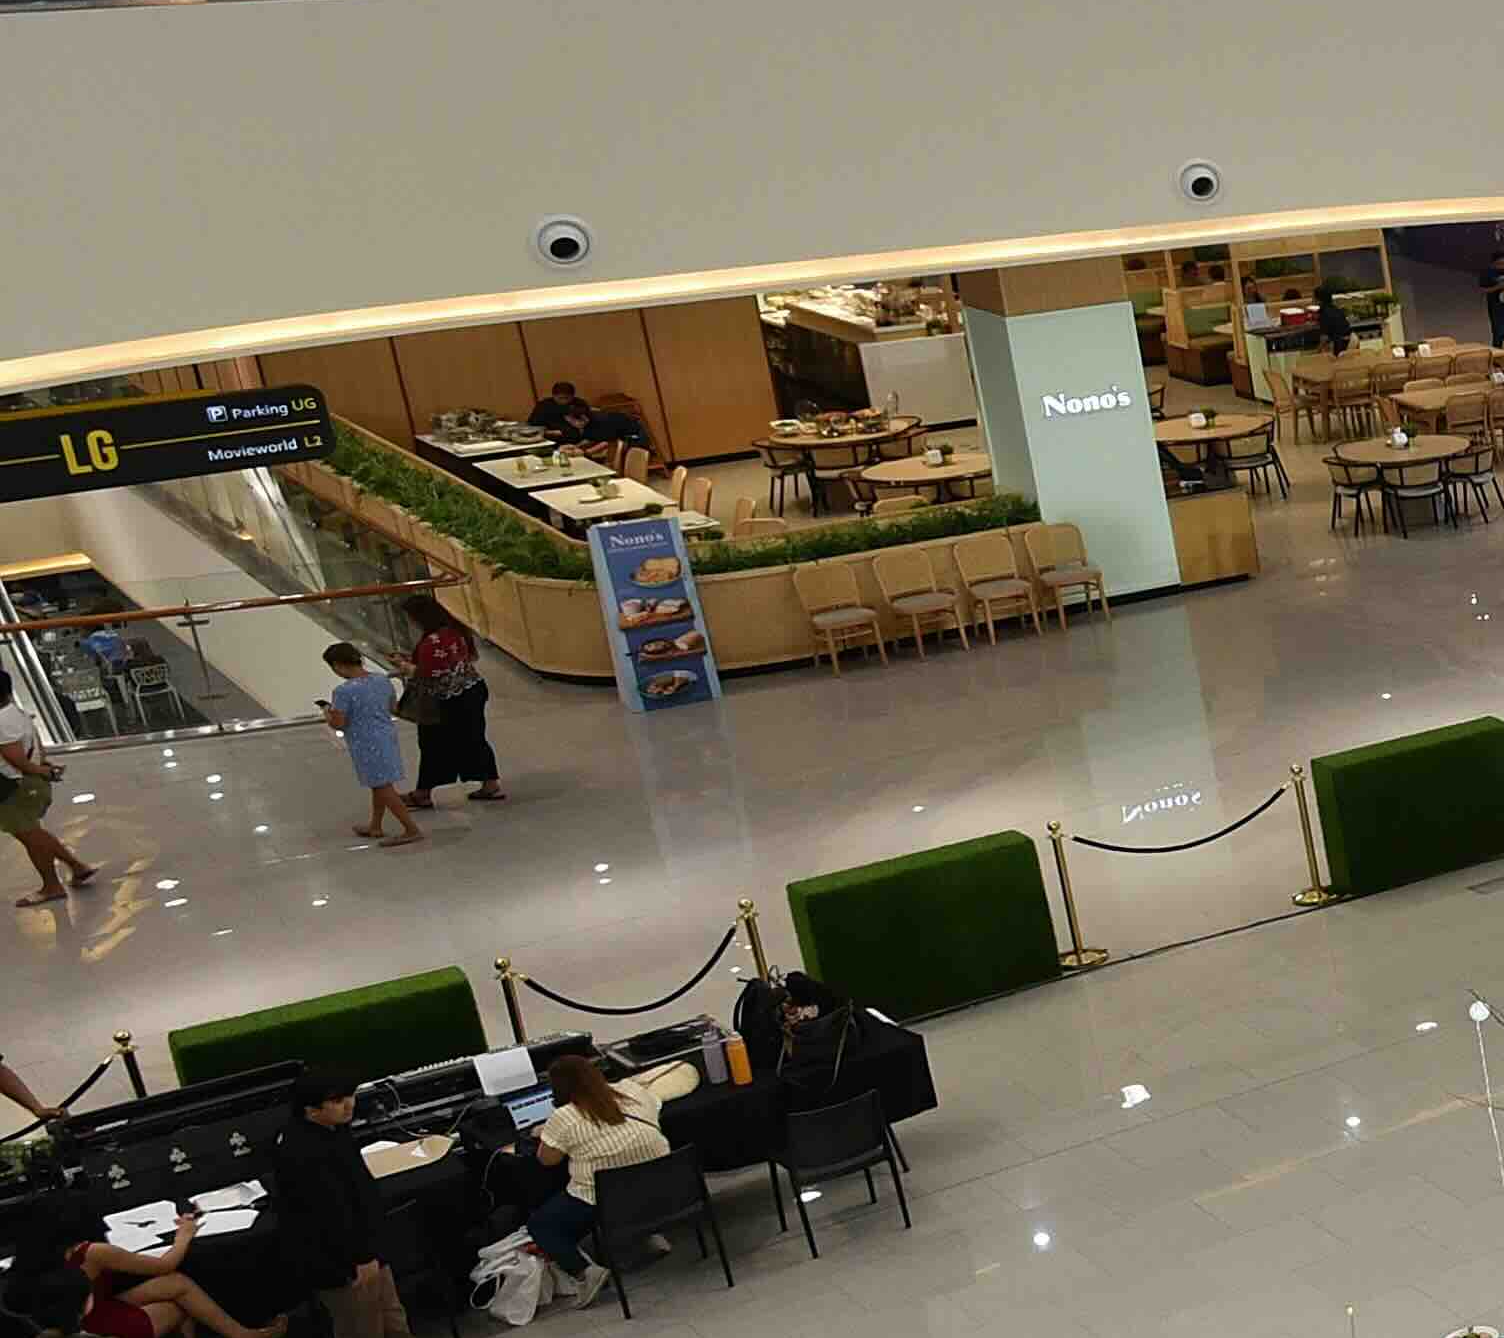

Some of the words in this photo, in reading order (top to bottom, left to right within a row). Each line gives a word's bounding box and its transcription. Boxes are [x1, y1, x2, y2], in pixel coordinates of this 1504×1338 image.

[232, 402, 289, 421] Parking
[292, 397, 319, 412] UG
[1042, 384, 1132, 418] Nono's
[60, 429, 119, 476] LG
[207, 438, 299, 462] Movieworld
[304, 436, 324, 450] L2
